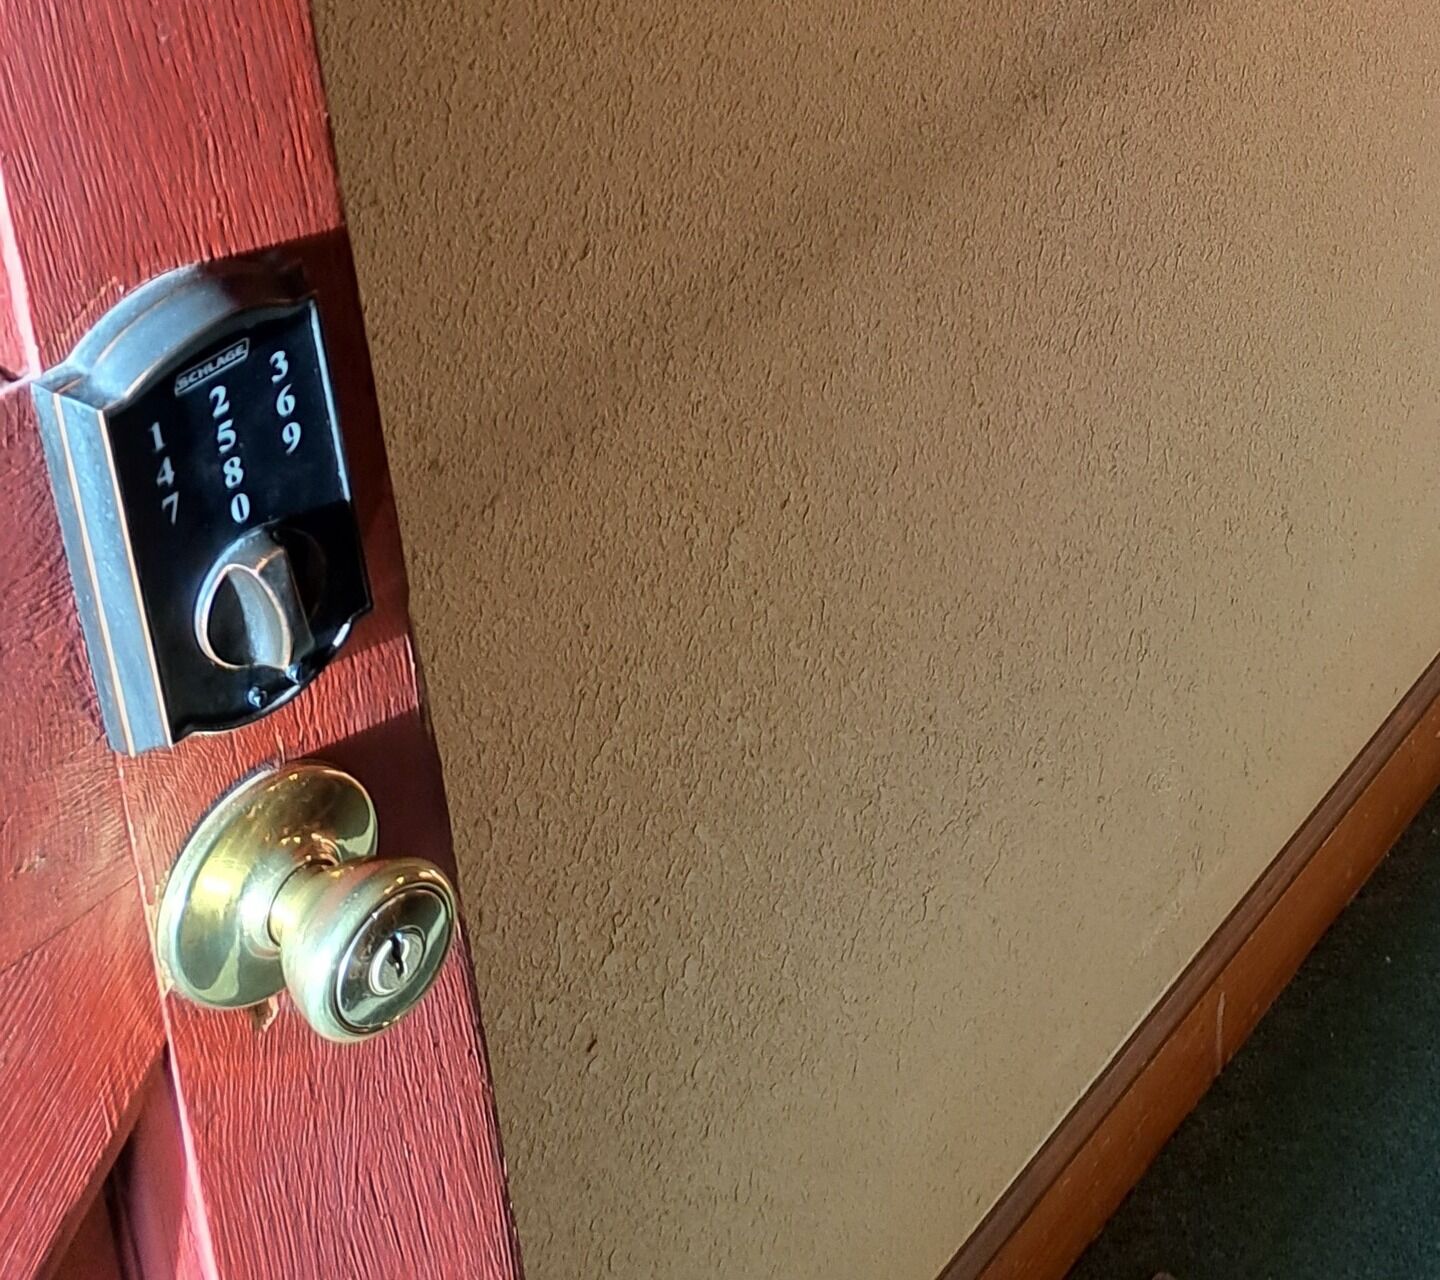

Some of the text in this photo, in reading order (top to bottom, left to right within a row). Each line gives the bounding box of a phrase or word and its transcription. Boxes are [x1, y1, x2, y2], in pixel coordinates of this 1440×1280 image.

[150, 350, 289, 453] 1 2 3
[177, 343, 245, 389] SCHLAGE
[156, 383, 296, 487] 4 5 6
[161, 422, 302, 526] 7 8 9
[230, 493, 250, 524] 0
